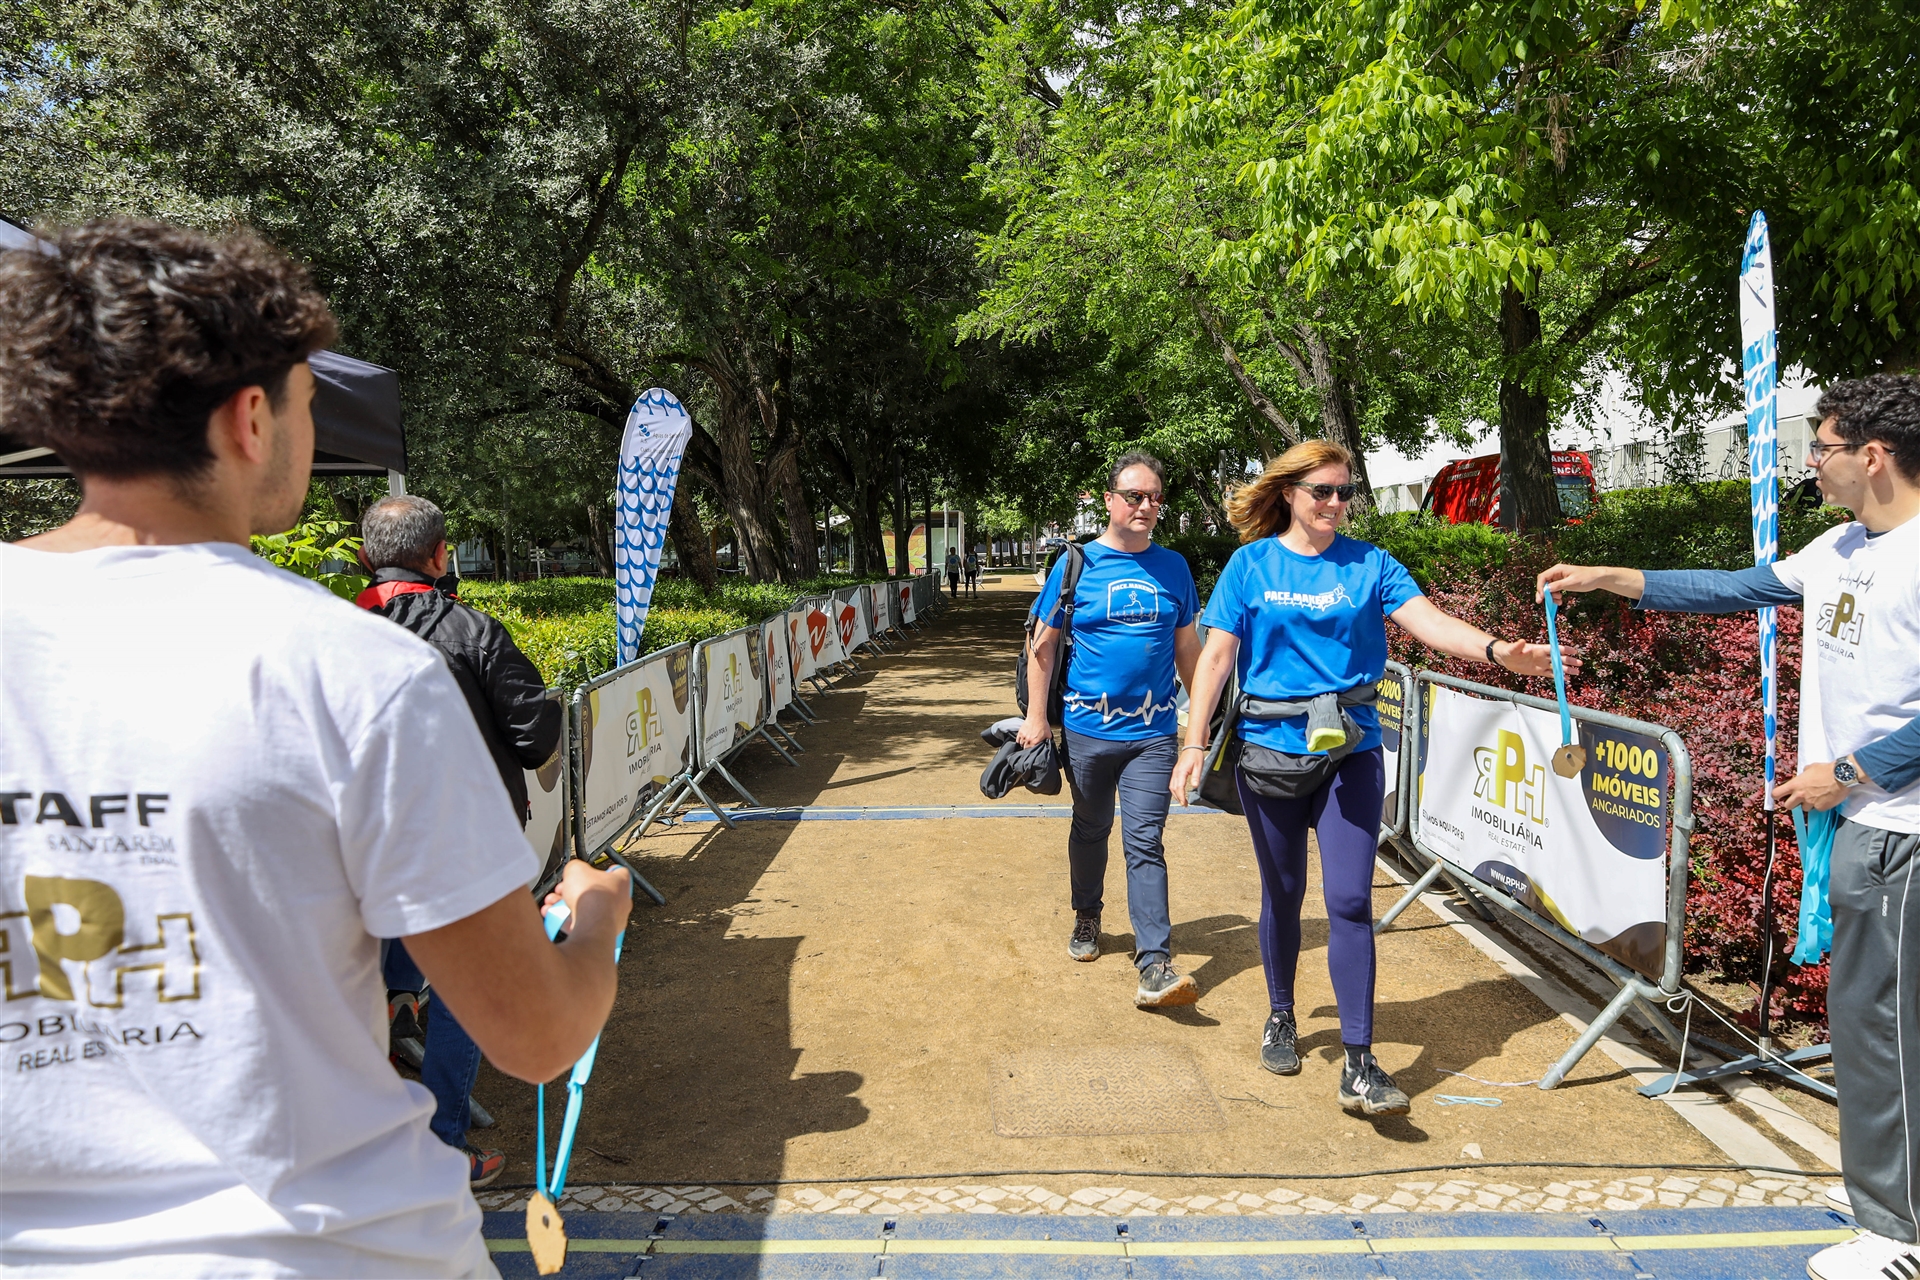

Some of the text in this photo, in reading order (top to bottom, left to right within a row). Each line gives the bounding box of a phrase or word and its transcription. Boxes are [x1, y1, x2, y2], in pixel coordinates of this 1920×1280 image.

[1376, 678, 1402, 702] +1000
[1376, 699, 1402, 720] MÓVEIS
[1595, 739, 1659, 779] +1000
[1592, 772, 1661, 809] IMÓVEIS
[0, 791, 169, 828] TAFF
[1592, 797, 1661, 829] ANGARIADOS
[1471, 805, 1543, 851] IMOBILIÁRIA
[1500, 837, 1527, 855] ESTATE
[1490, 867, 1528, 894] WWW.RPH.PT
[17, 1043, 75, 1072] REAL
